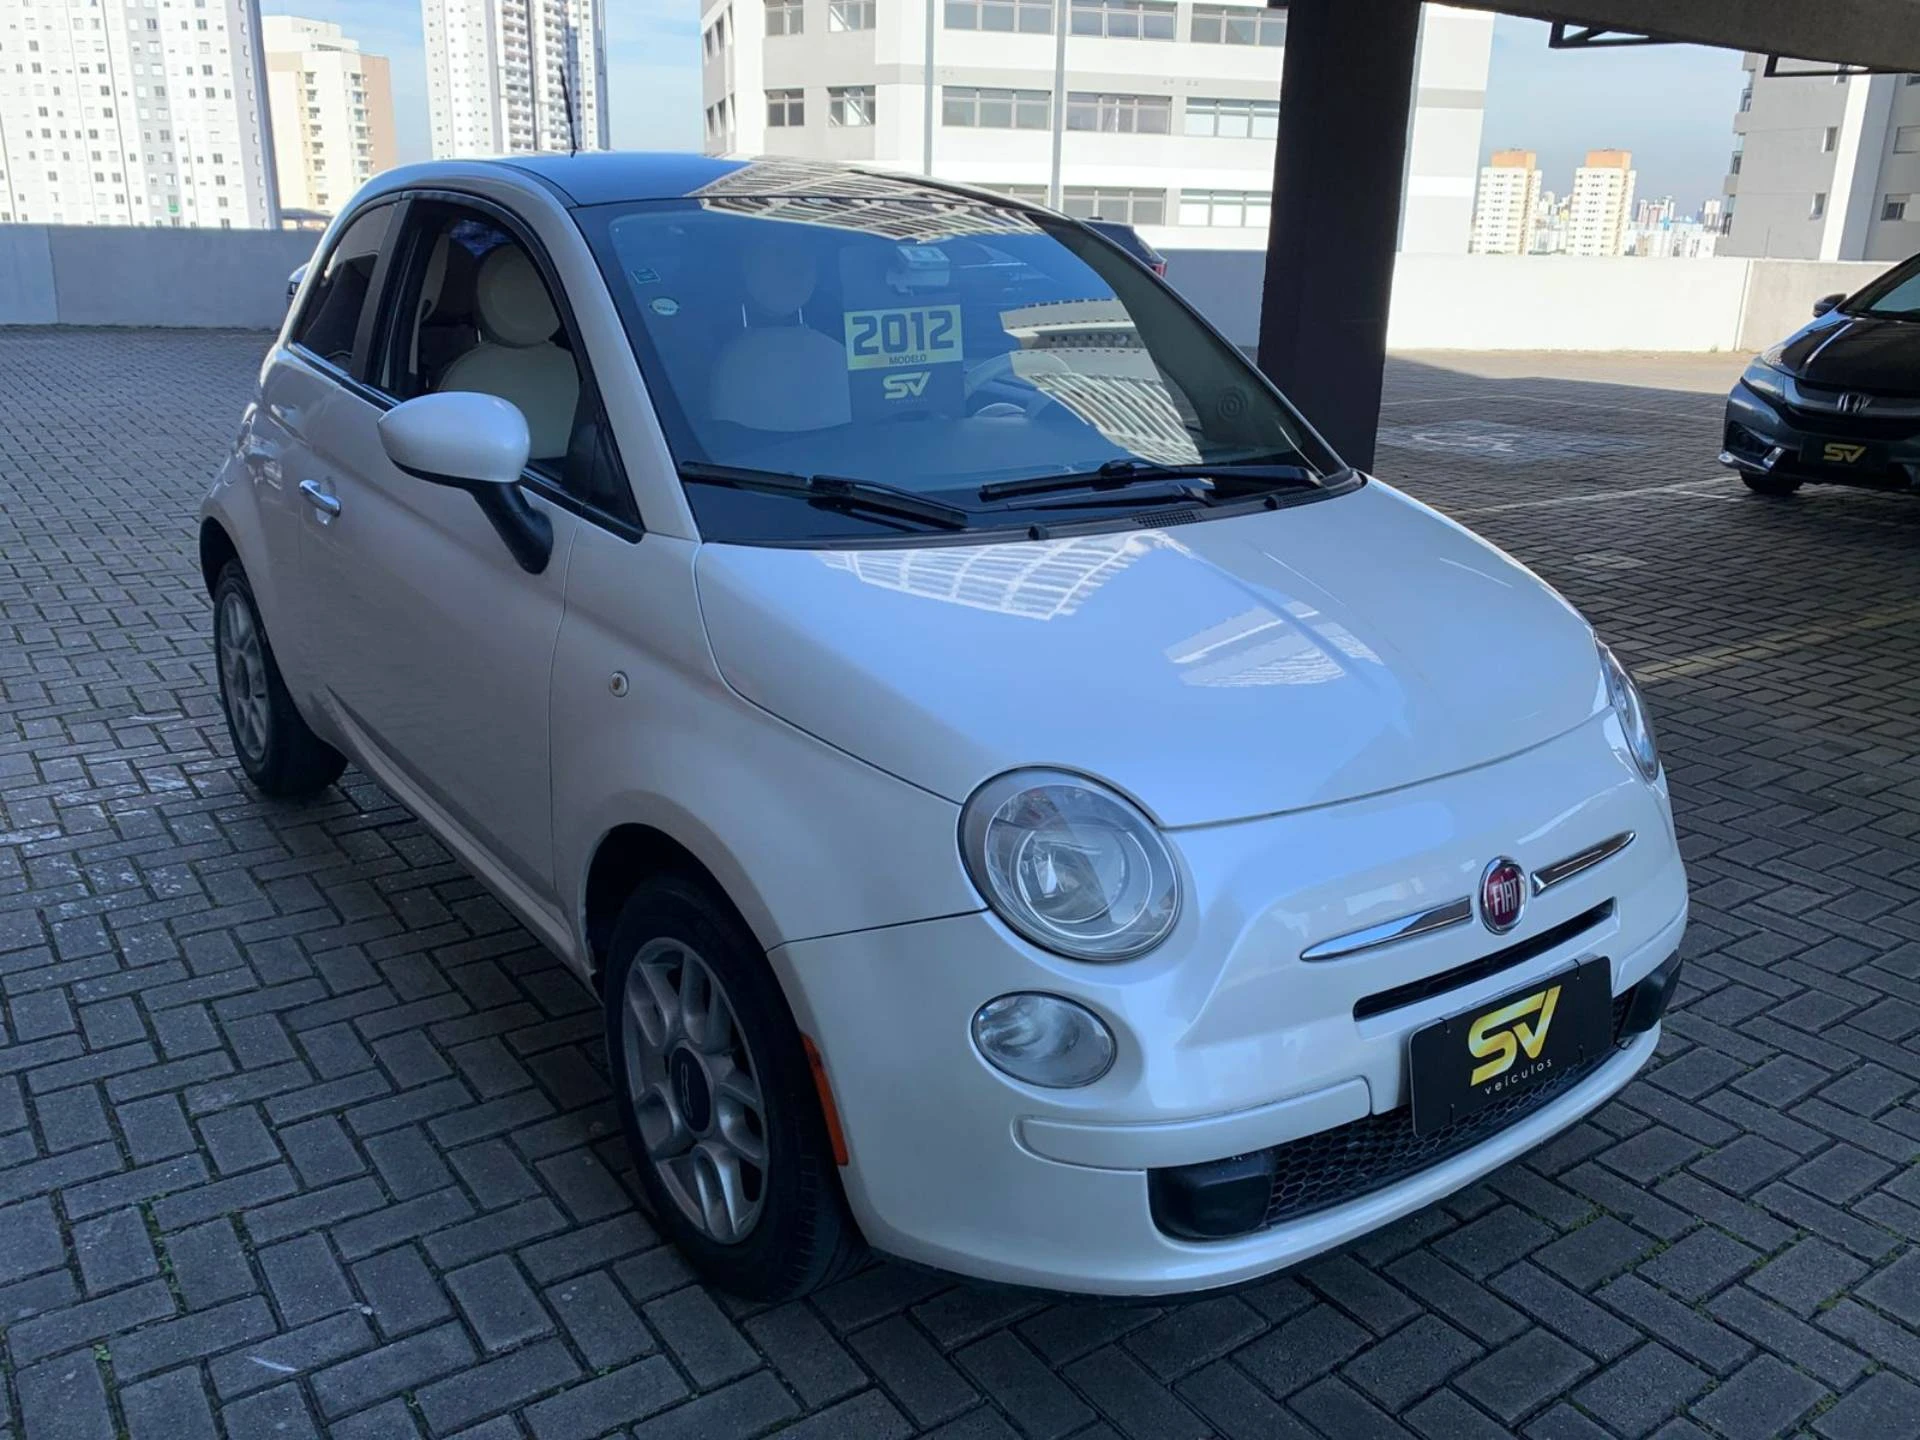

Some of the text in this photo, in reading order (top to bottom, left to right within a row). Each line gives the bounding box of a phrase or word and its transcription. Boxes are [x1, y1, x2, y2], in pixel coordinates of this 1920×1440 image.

[852, 310, 954, 356] 2012
[889, 354, 927, 366] MODELO
[883, 371, 931, 400] SV
[1489, 877, 1519, 917] FIAT
[1468, 985, 1562, 1087] SV
